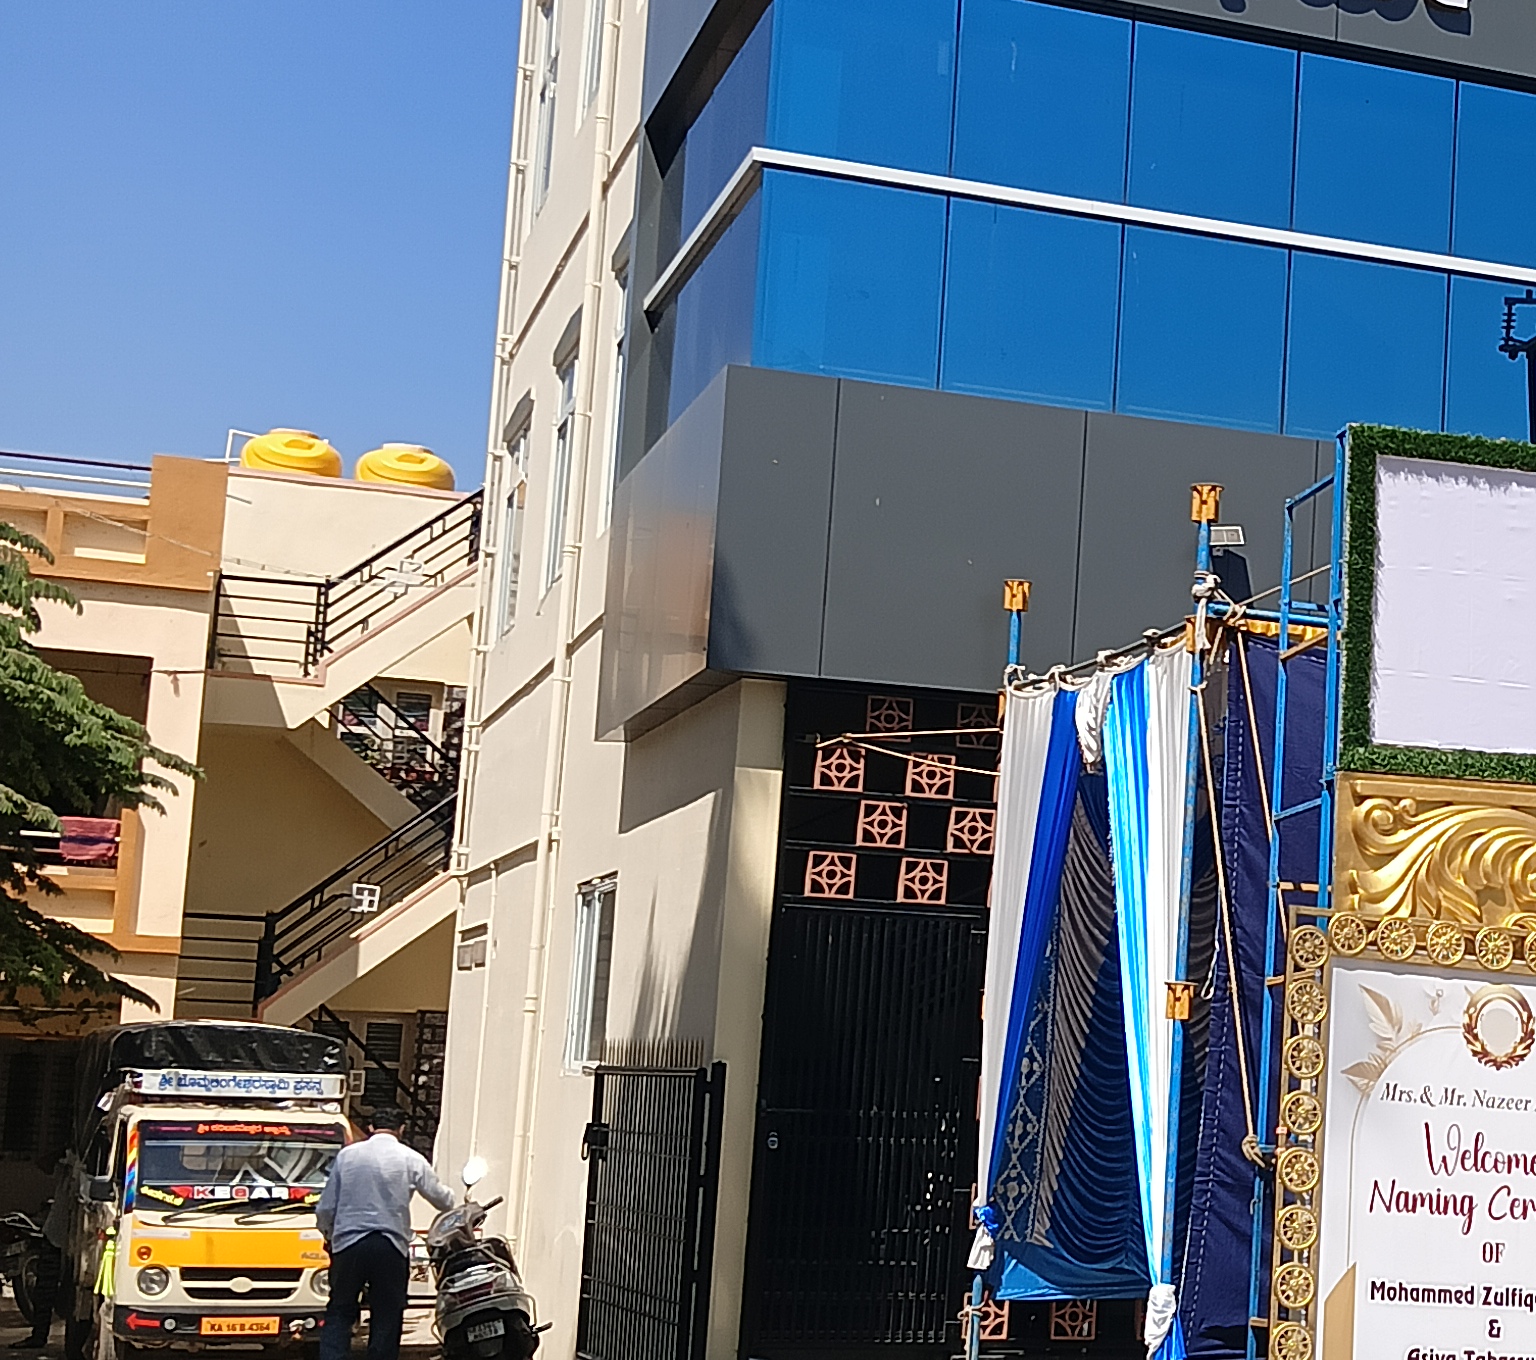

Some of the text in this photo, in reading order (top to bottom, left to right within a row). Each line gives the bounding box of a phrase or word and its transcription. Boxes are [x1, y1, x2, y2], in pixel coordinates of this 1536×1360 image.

[158, 1073, 173, 1091] ಶ್ರೀ
[293, 1077, 324, 1095] ಪ್ರಸನ್ನ
[1439, 1087, 1467, 1107] Mr.
[1472, 1089, 1532, 1112] Nazeer
[1369, 1179, 1479, 1236] Naming
[1481, 1241, 1506, 1264] OF
[1370, 1280, 1475, 1306] Mohammed
[210, 1323, 222, 1332] KA
[1487, 1319, 1502, 1339] &
